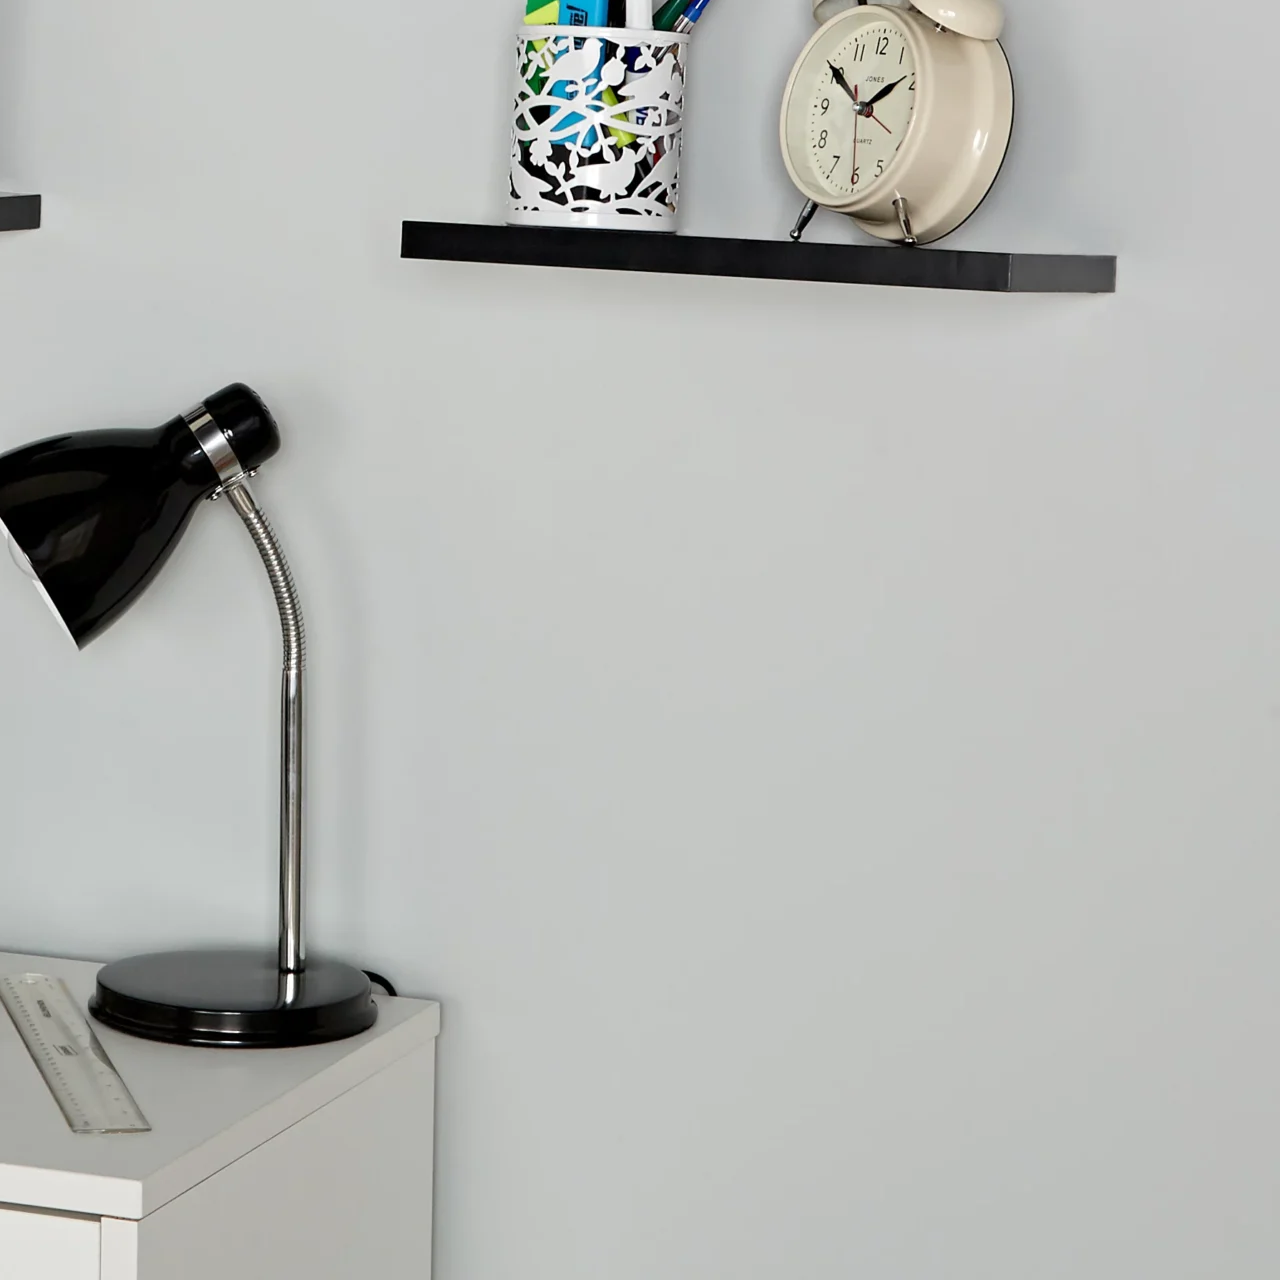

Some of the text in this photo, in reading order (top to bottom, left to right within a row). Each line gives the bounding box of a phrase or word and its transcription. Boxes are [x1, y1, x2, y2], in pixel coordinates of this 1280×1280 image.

[853, 43, 866, 62] 11
[875, 36, 889, 56] 12
[899, 47, 905, 65] 1
[820, 97, 830, 116] 9
[817, 129, 828, 149] 8
[829, 155, 841, 174] 7
[874, 159, 884, 178] 5
[851, 166, 860, 186] 6
